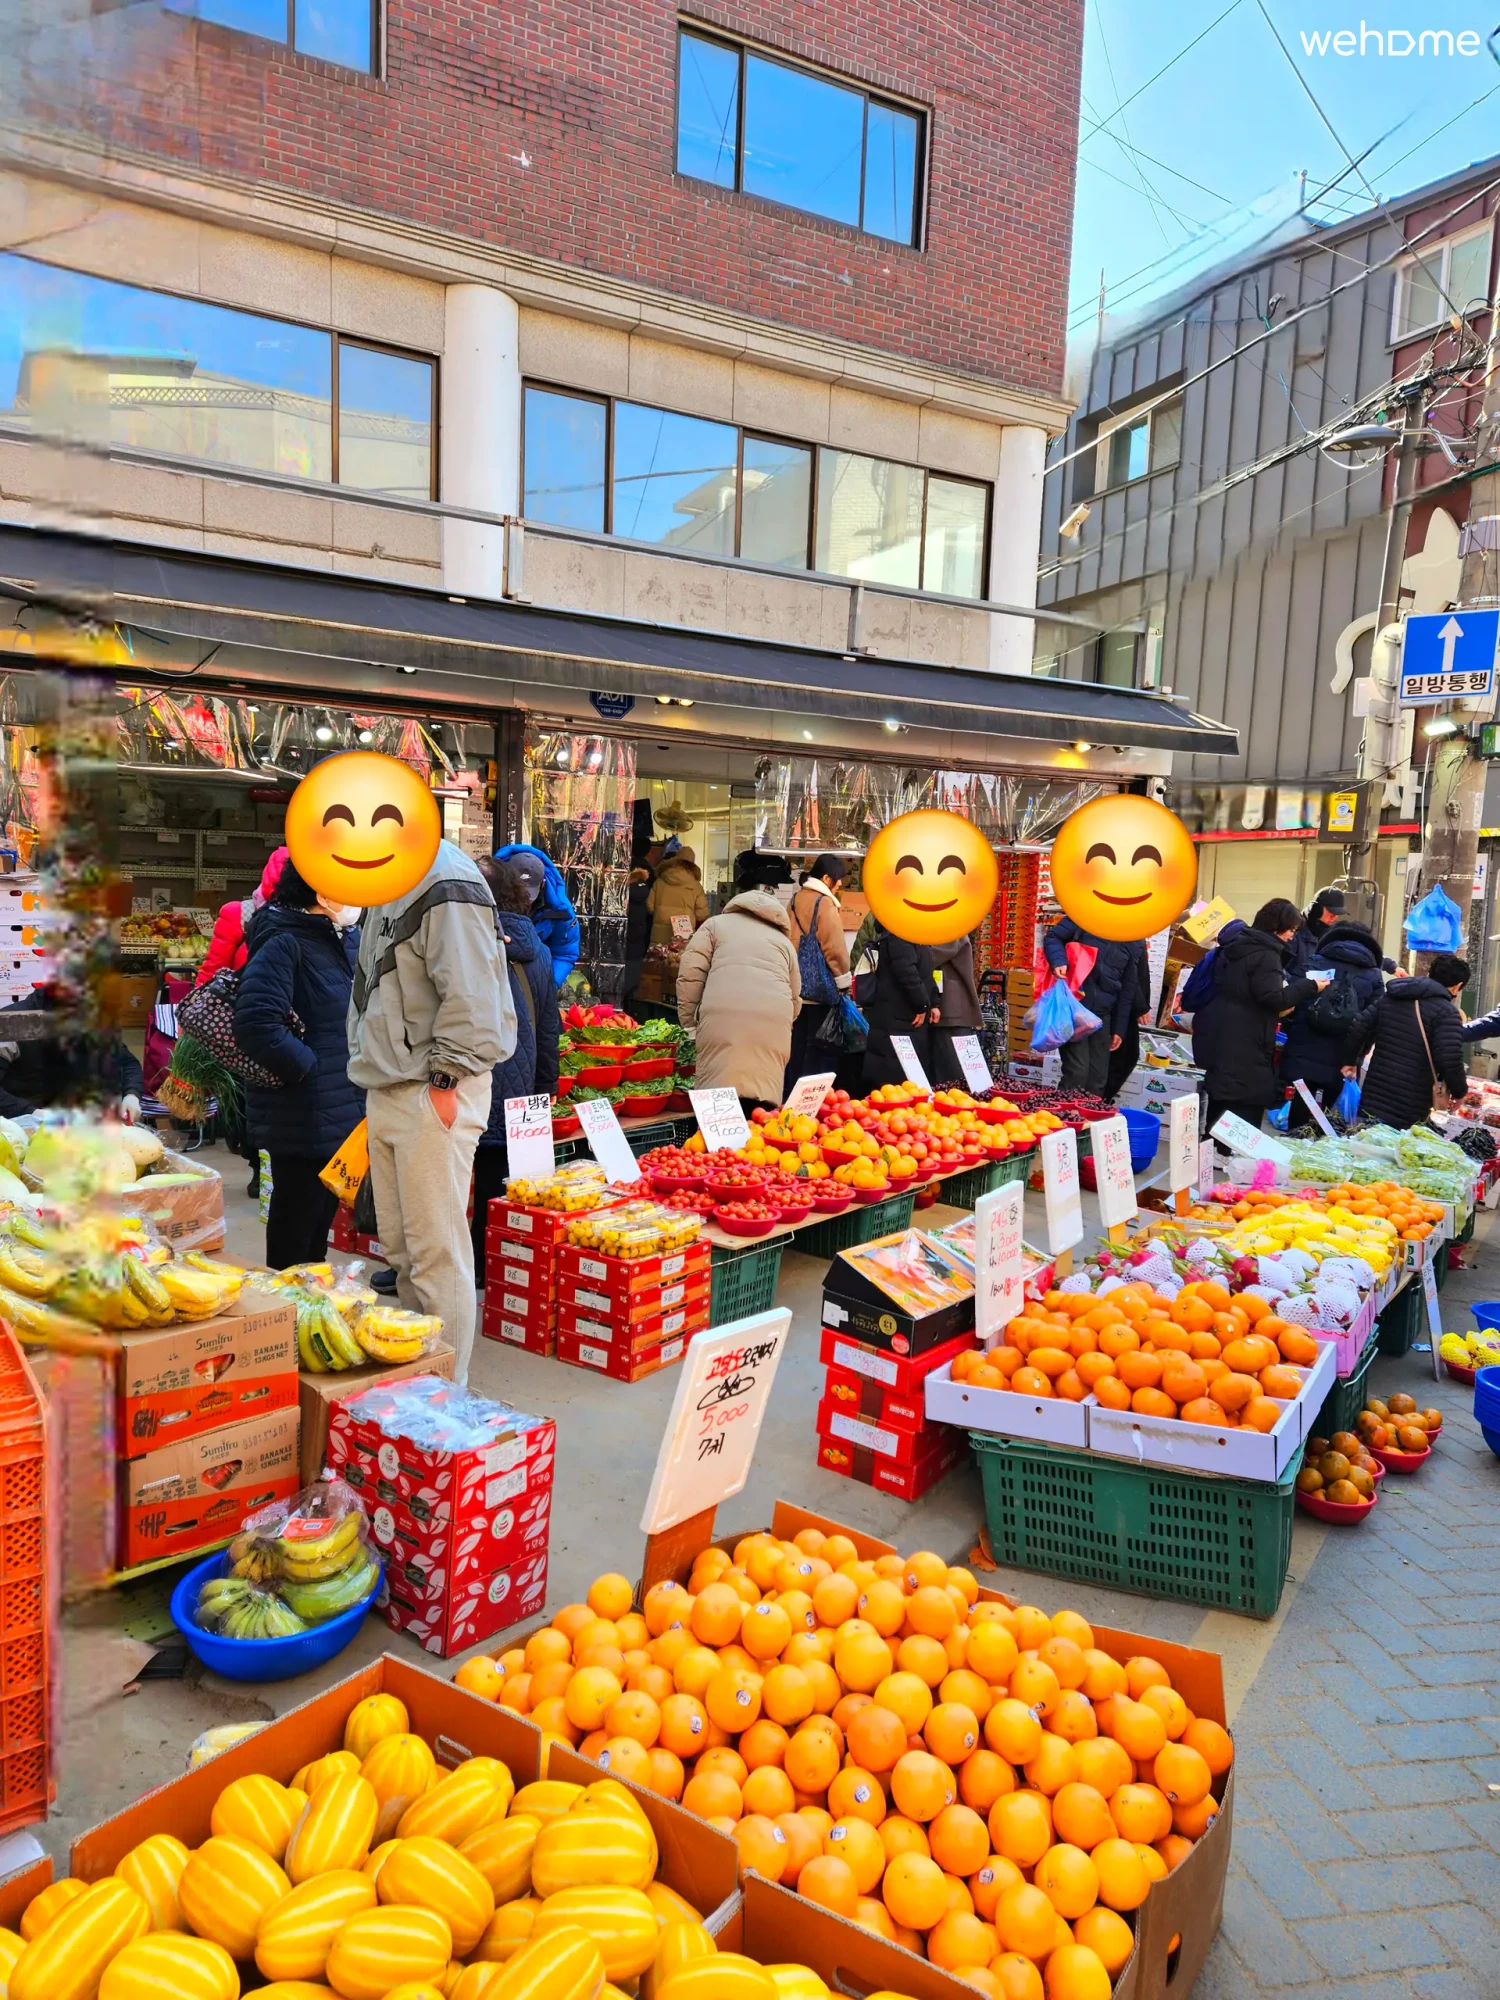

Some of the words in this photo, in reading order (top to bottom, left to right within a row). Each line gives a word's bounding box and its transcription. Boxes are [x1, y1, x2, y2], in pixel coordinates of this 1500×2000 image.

[1406, 671, 1488, 695] 일방통행
[528, 1095, 550, 1110] 방울
[195, 1333, 233, 1351] Sumifru
[254, 1341, 289, 1357] BANANAS
[200, 1440, 239, 1459] Sumifru
[260, 1444, 293, 1462] BANANAS
